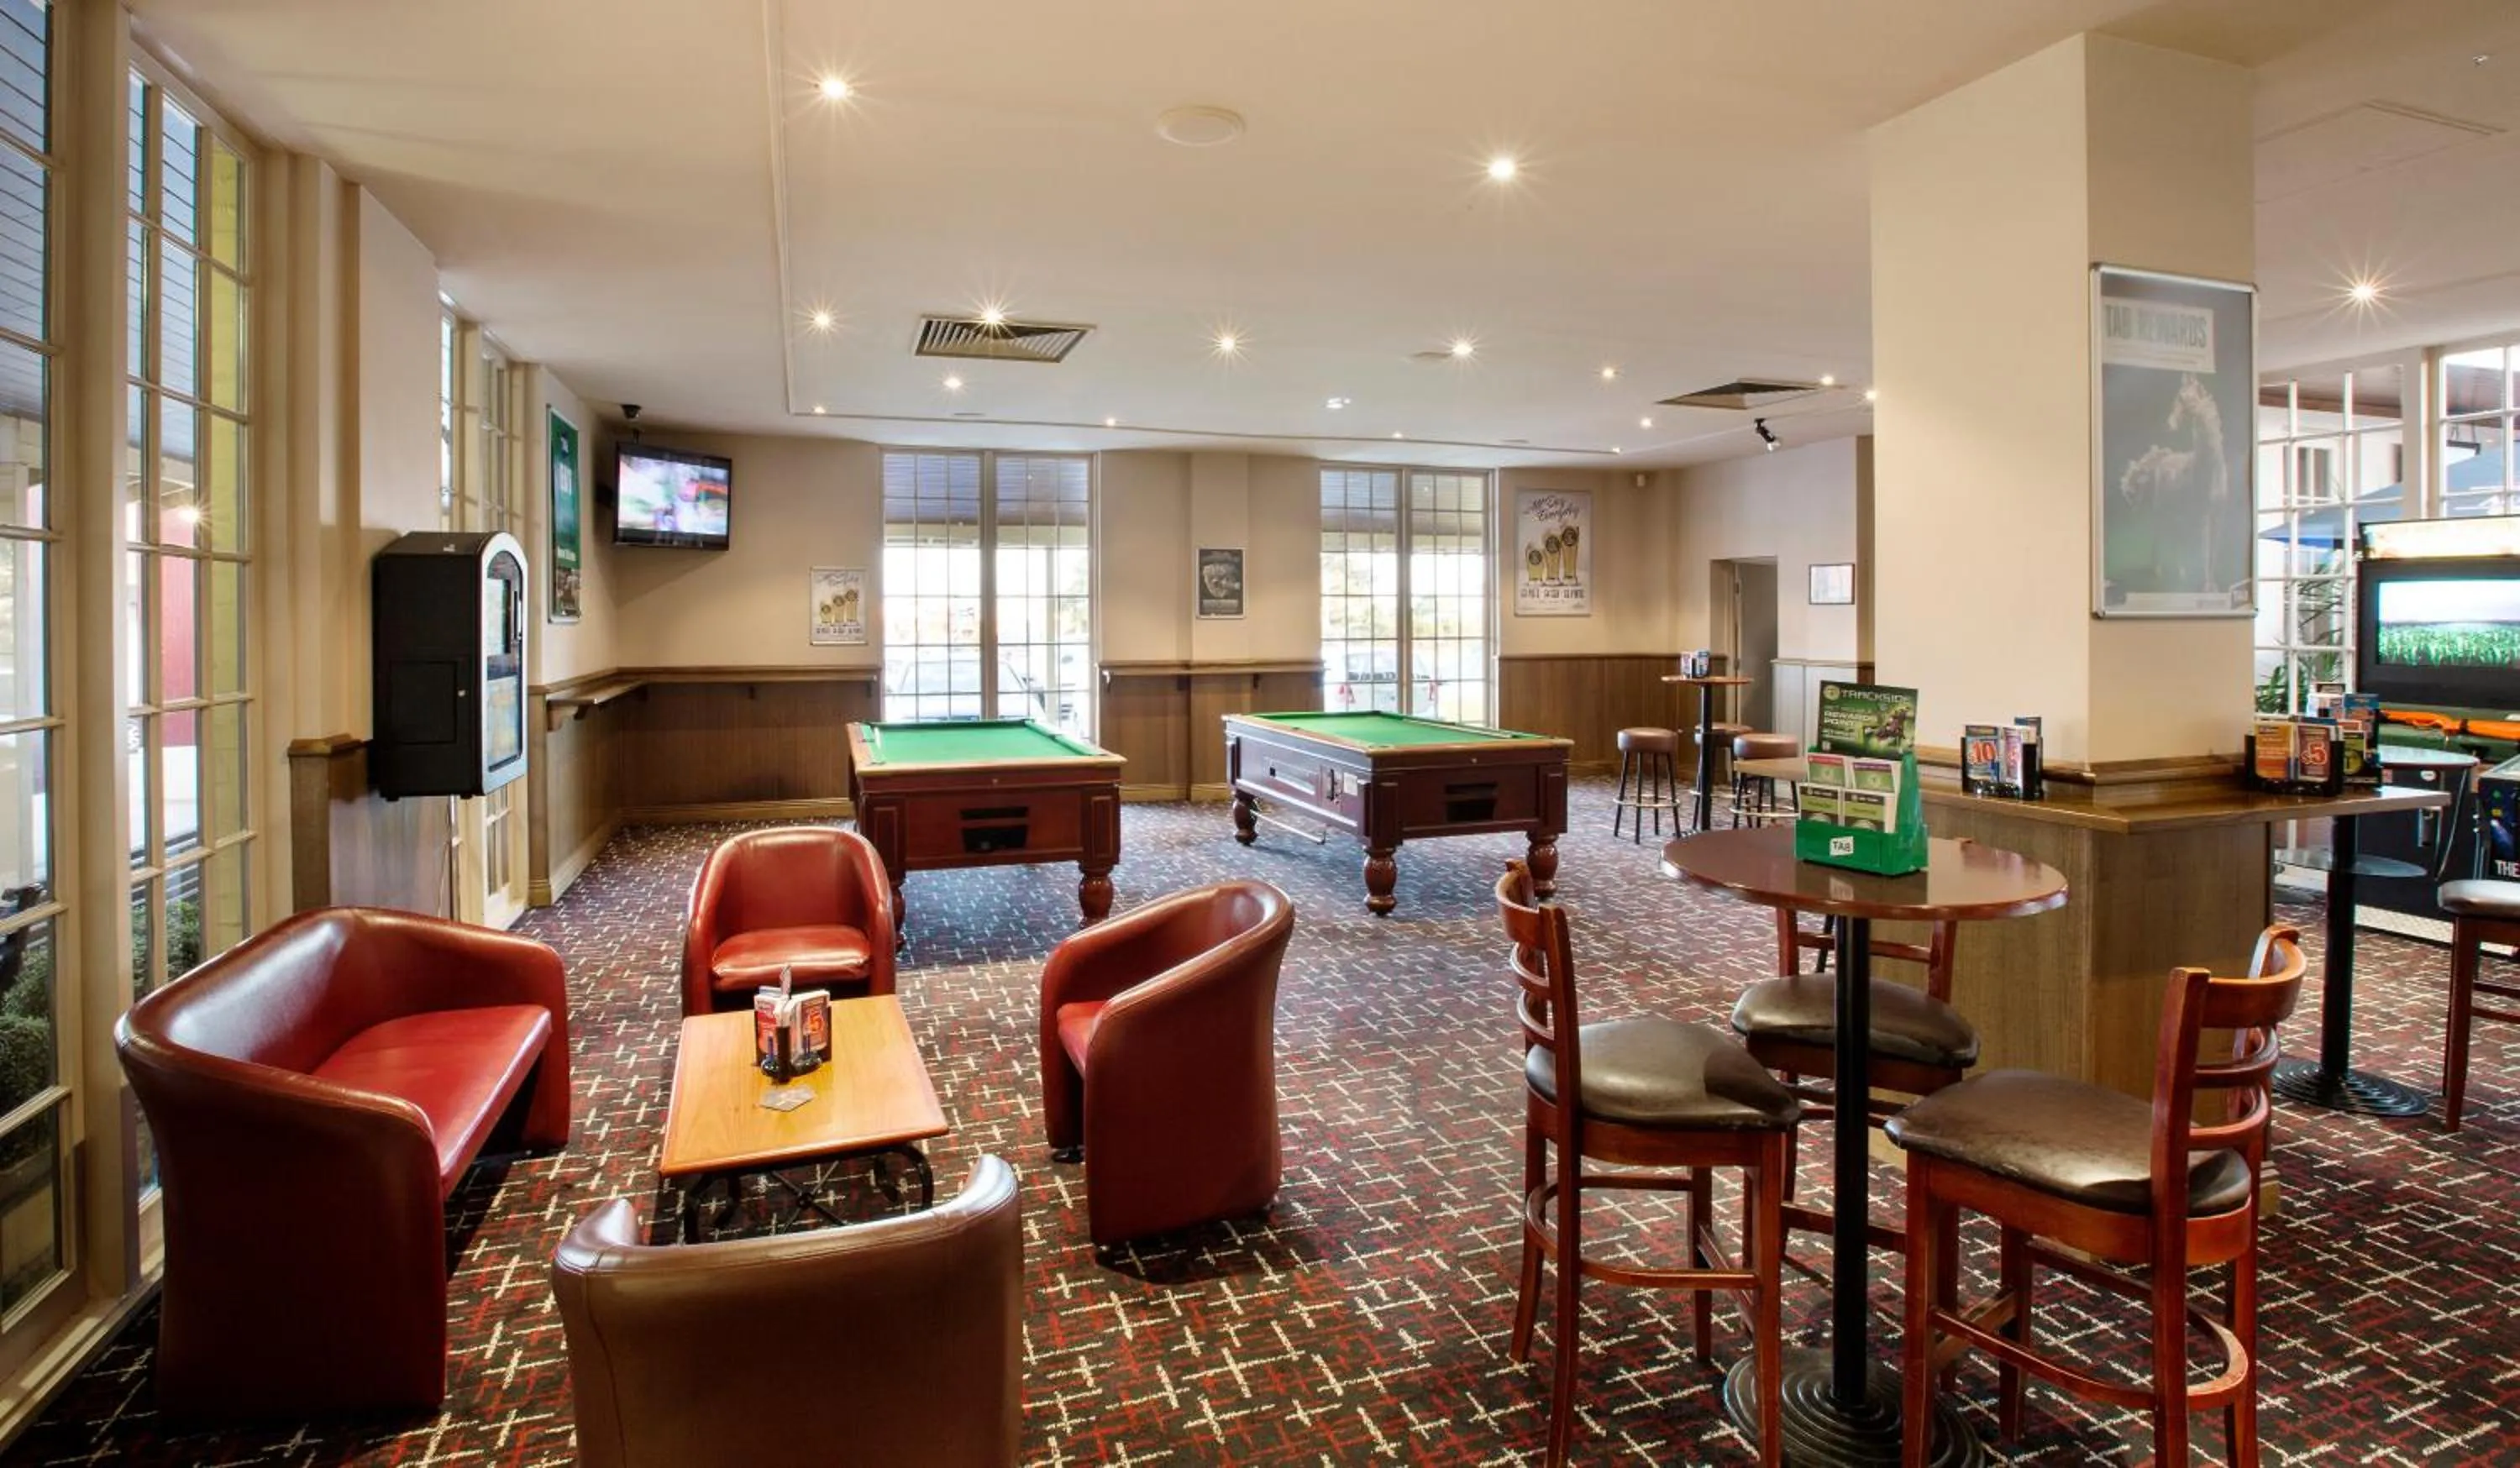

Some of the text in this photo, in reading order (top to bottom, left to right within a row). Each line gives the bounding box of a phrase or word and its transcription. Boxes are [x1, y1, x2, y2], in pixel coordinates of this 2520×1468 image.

[1840, 689, 1909, 704] TRACKSIDE
[1832, 841, 1851, 852] TAB
[2494, 859, 2520, 878] THE
